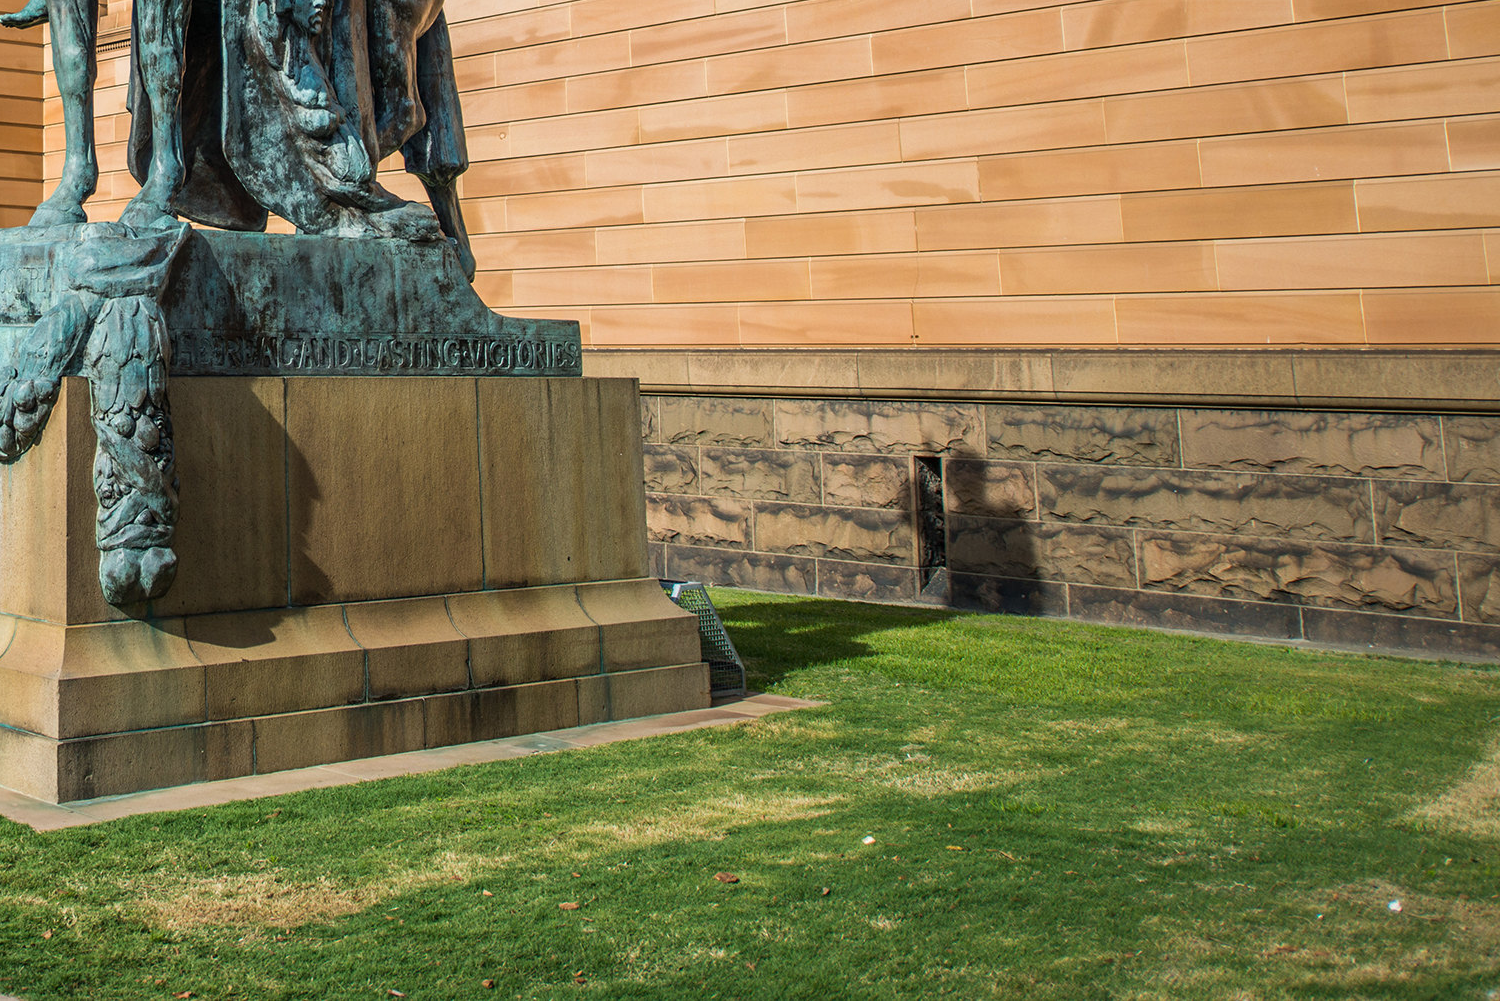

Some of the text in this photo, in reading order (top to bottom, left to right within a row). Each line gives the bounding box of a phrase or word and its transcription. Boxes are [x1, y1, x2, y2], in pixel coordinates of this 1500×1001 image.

[299, 338, 350, 369] AND
[360, 338, 461, 370] LASTING
[466, 338, 578, 370] VICTORIES
